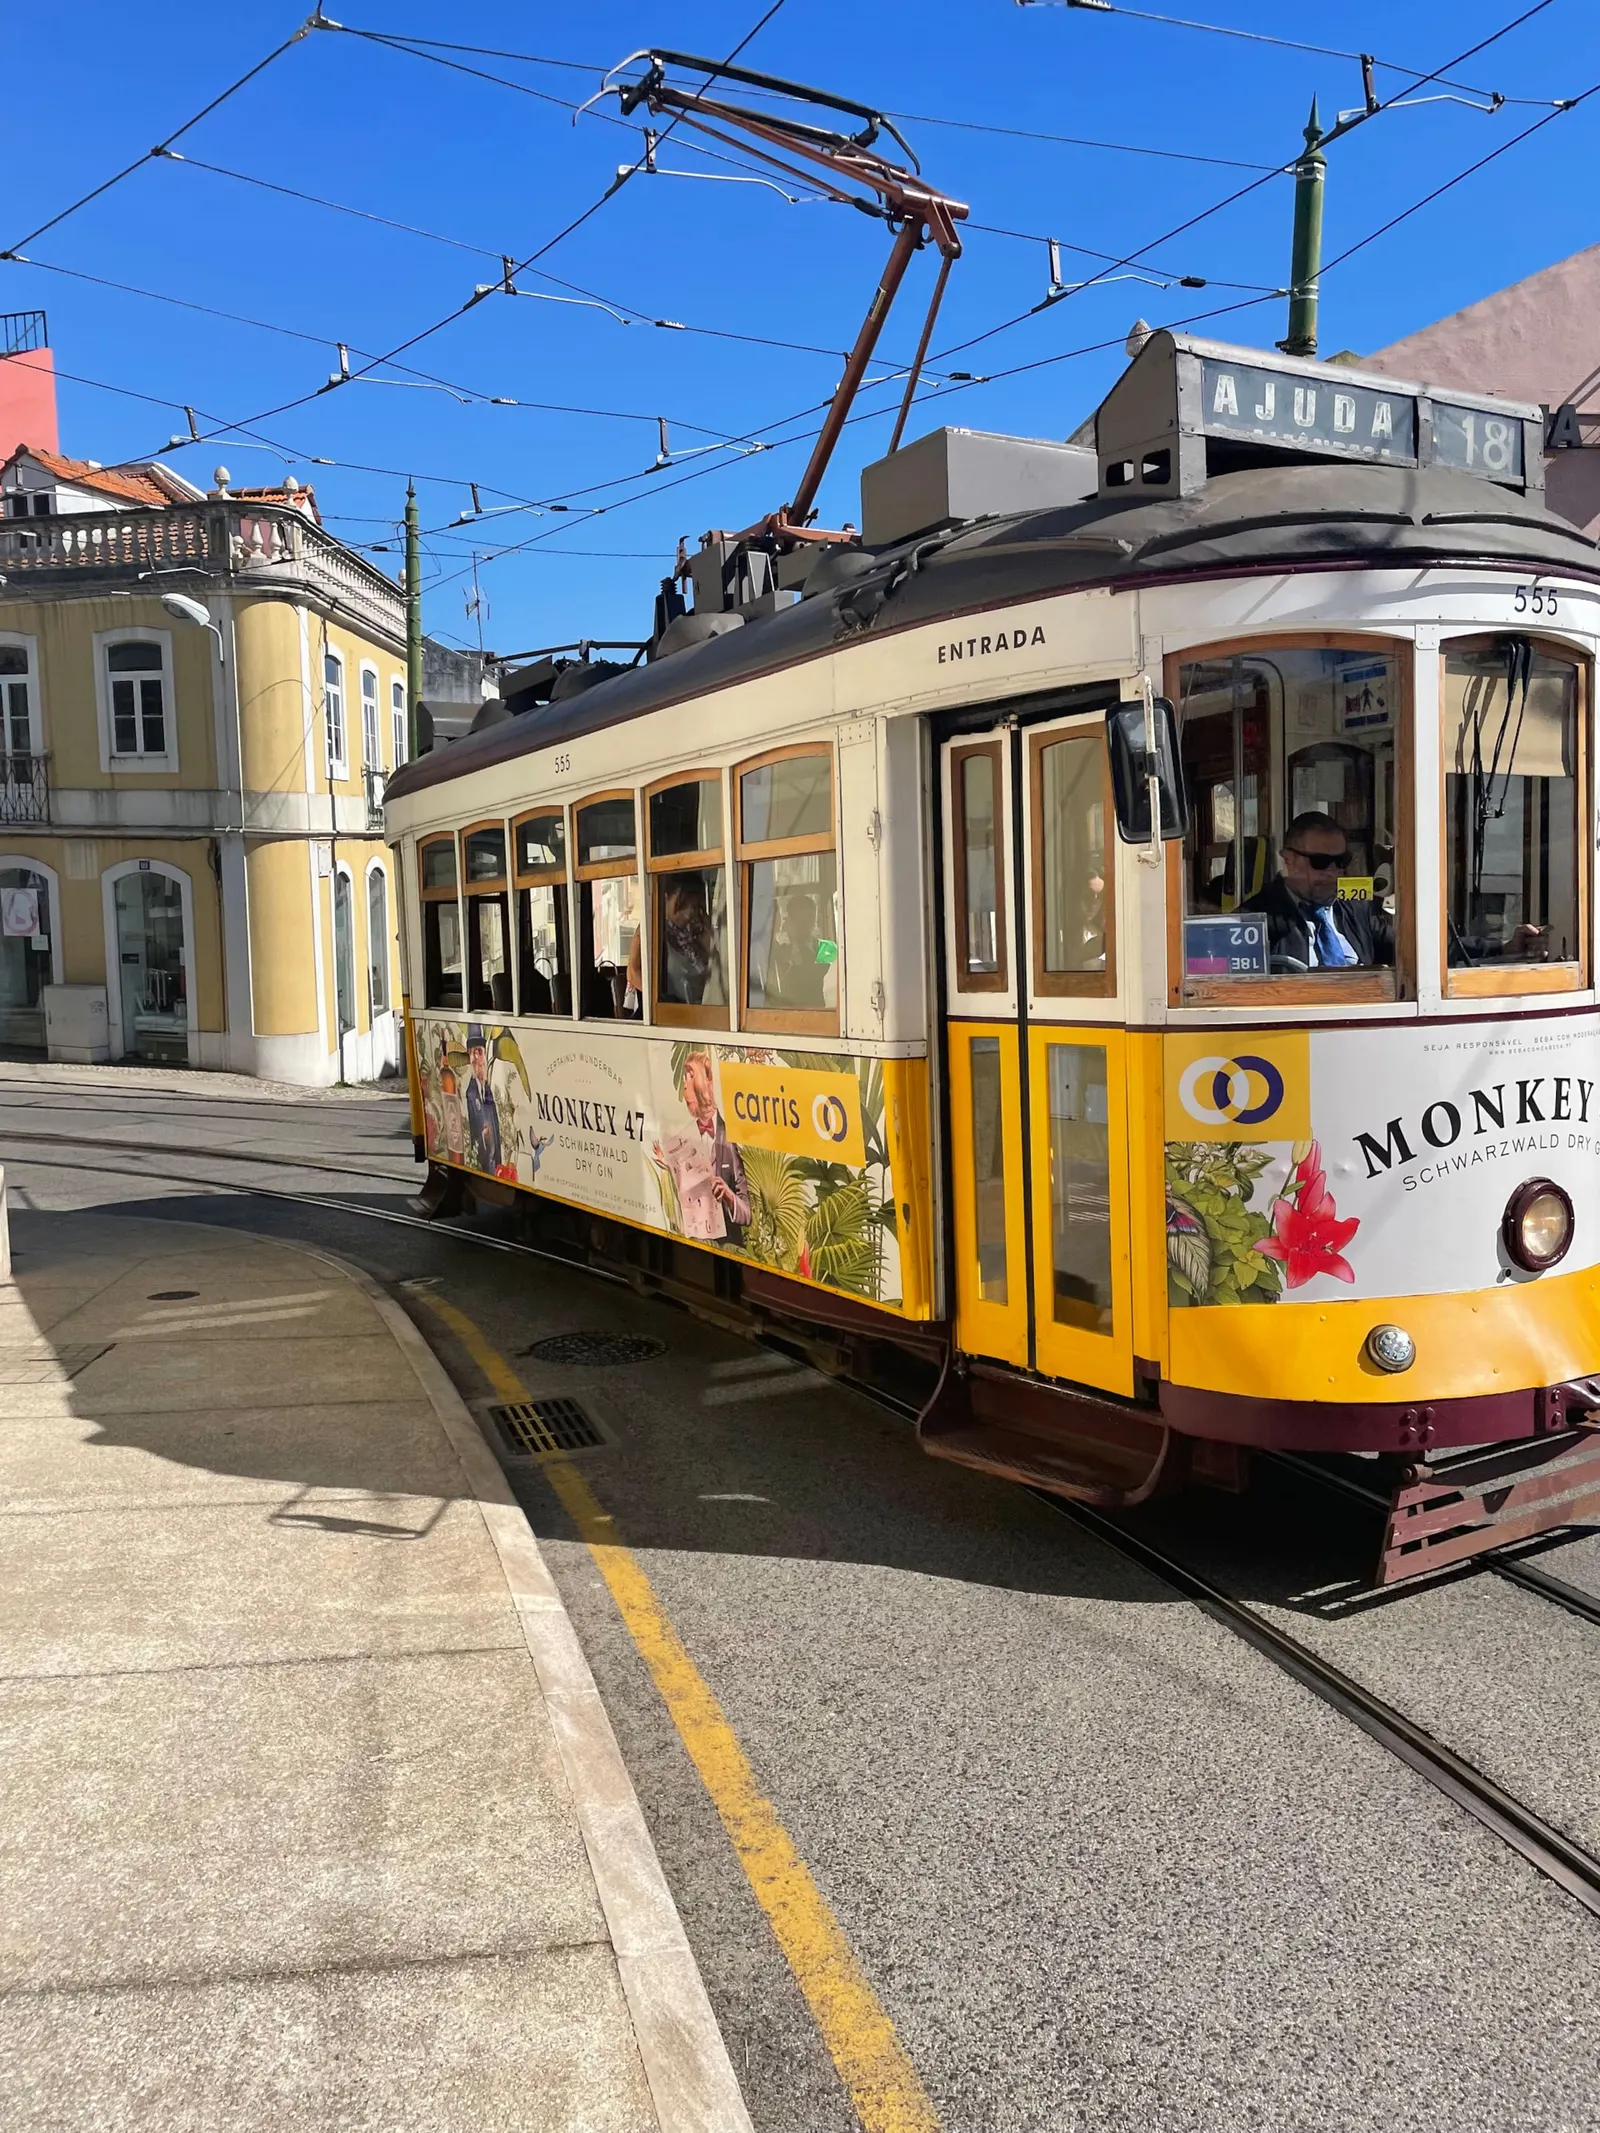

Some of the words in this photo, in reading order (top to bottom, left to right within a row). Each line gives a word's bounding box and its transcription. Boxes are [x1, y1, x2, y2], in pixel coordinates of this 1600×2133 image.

[1213, 374, 1393, 440] AJUDA
[1462, 415, 1508, 470] 18
[1514, 585, 1558, 616] 555
[938, 626, 1046, 664] ENTRADA
[555, 754, 571, 774] 555
[1338, 888, 1367, 901] 3.20
[1229, 926, 1259, 946] 02
[1231, 957, 1260, 970] 18E
[1423, 1044, 1450, 1052] SEJA
[536, 1092, 617, 1136] MONKEY
[624, 1110, 645, 1142] 47
[734, 1085, 800, 1129] carris
[1352, 1077, 1595, 1179] MONKEY
[559, 1135, 628, 1163] SCHWARZWALD
[1402, 1133, 1560, 1191] SCHWARZWALD
[1568, 1133, 1591, 1151] DRY
[575, 1158, 592, 1174] DRY
[597, 1164, 613, 1179] GIN
